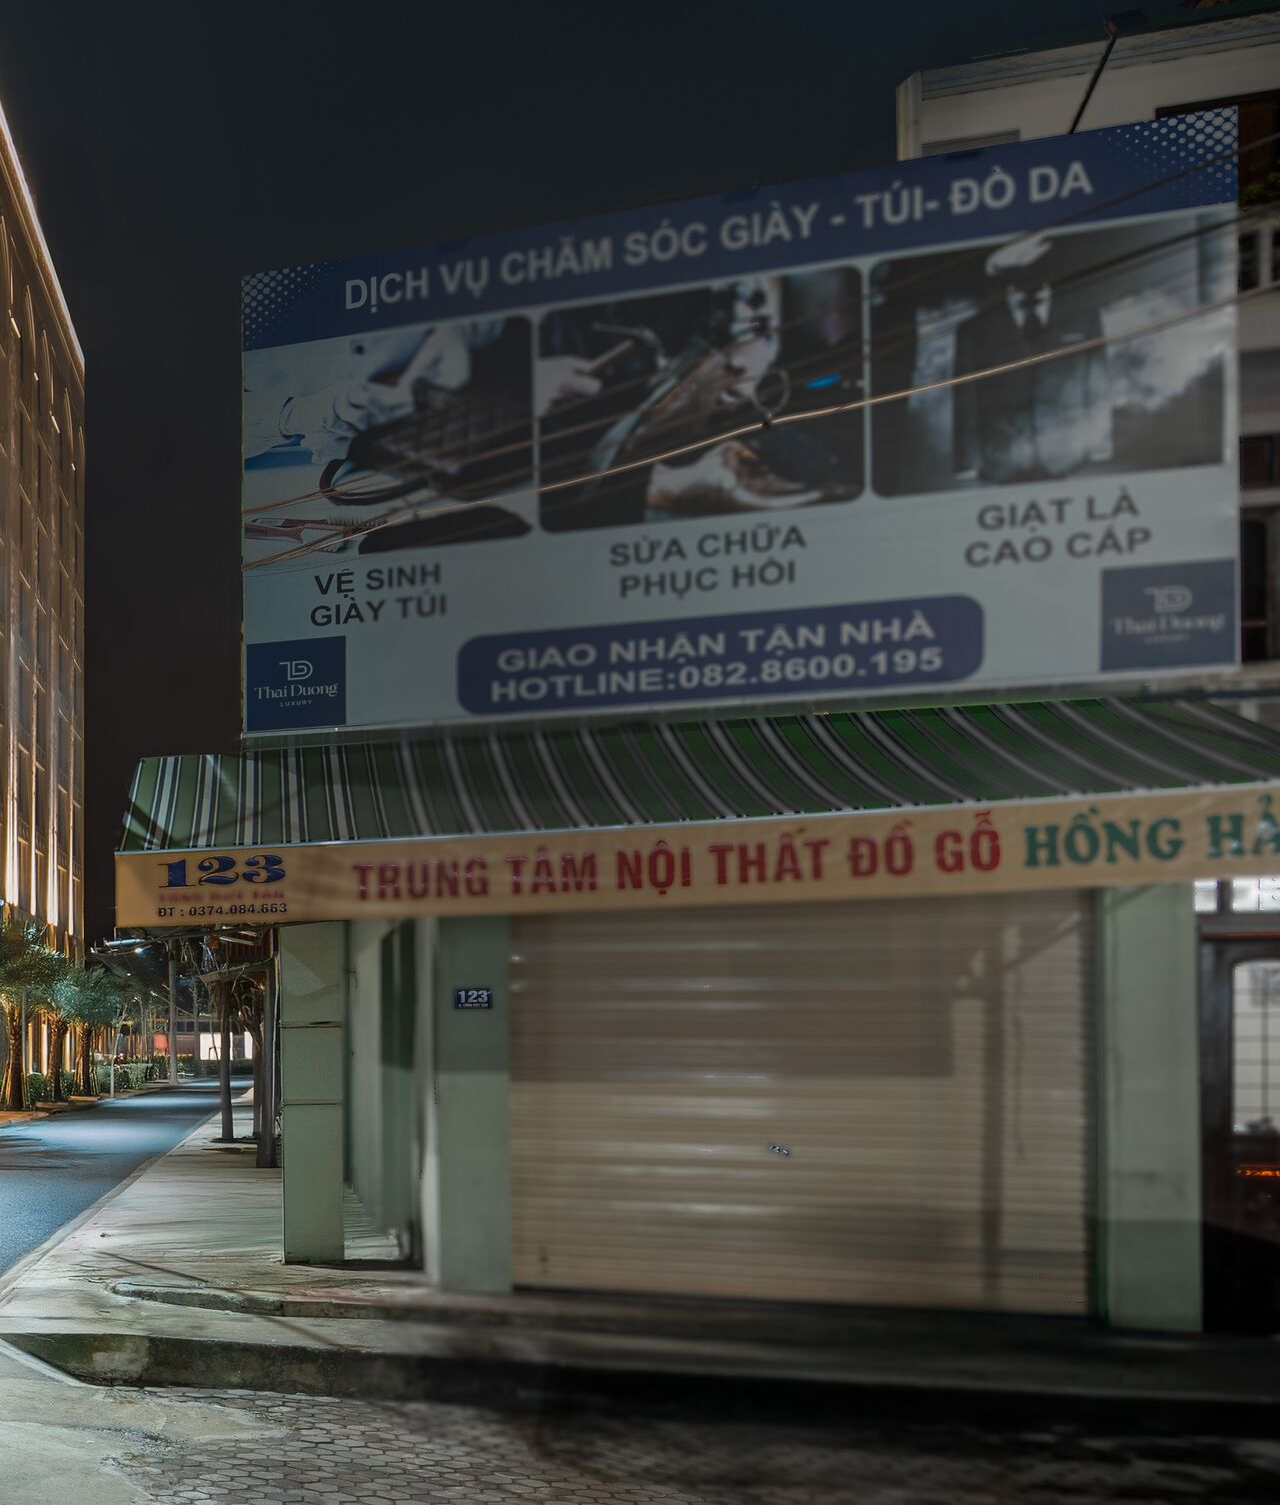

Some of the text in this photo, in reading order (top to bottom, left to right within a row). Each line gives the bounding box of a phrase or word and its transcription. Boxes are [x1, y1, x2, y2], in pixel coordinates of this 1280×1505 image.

[345, 267, 428, 313] DỊCH
[440, 257, 489, 298] VỤ
[500, 235, 613, 286] CHĂM
[623, 218, 707, 267] SÓC
[720, 202, 819, 251] GIÀY
[1028, 161, 1093, 203] DA
[965, 535, 1053, 568] CAO
[314, 562, 441, 598] VỆ SINH
[620, 564, 718, 599] PHỤC
[310, 589, 447, 627] GIÀY TÚI
[496, 609, 935, 673] GIAO NHẬN TẬN NHÀ
[253, 681, 339, 700] Thai Duong
[269, 699, 313, 707] LUXURY
[157, 854, 287, 889] 123
[352, 857, 489, 902] TRUNG
[505, 845, 597, 894] TÂM
[617, 839, 691, 895] NỘI
[709, 827, 830, 886] THẤT
[847, 819, 914, 877] ĐỒ
[935, 809, 1000, 873] GỖ
[1024, 806, 1183, 869] HỒNG
[157, 906, 176, 917] ĐT
[458, 990, 488, 1003] 123
